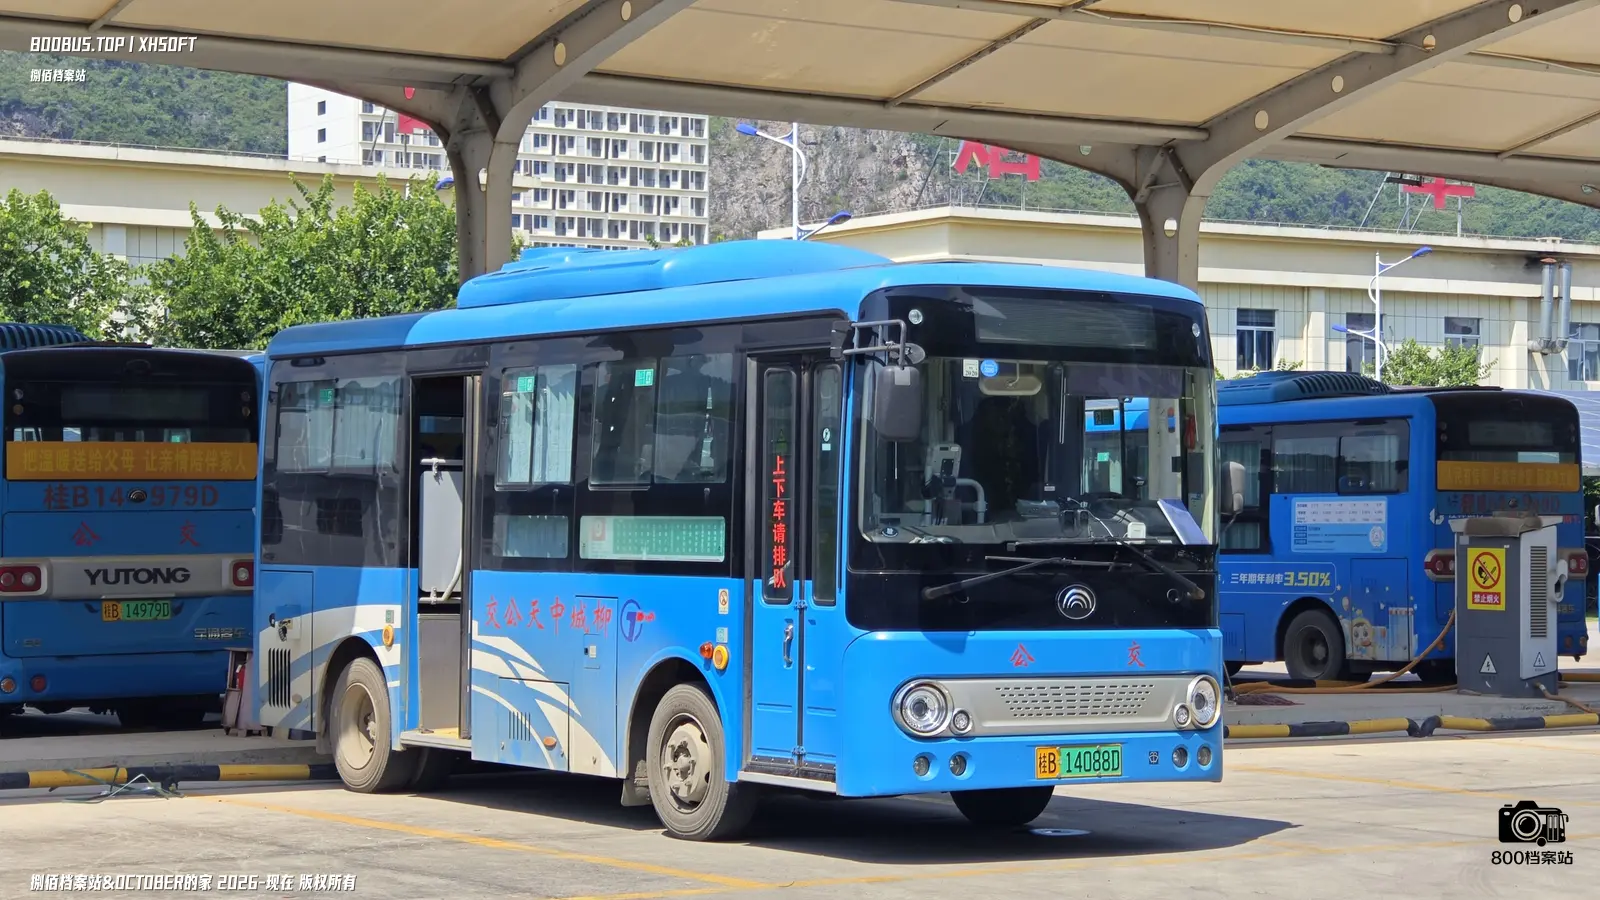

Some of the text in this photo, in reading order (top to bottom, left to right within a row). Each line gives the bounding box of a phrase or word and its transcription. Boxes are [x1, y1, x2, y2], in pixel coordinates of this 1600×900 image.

[23, 448, 247, 472] 把温暖送给父母 让亲情陪伴家人
[772, 455, 787, 589] 上下车请排队
[84, 567, 191, 586] YUTONG
[1473, 593, 1500, 604] 禁止烟火
